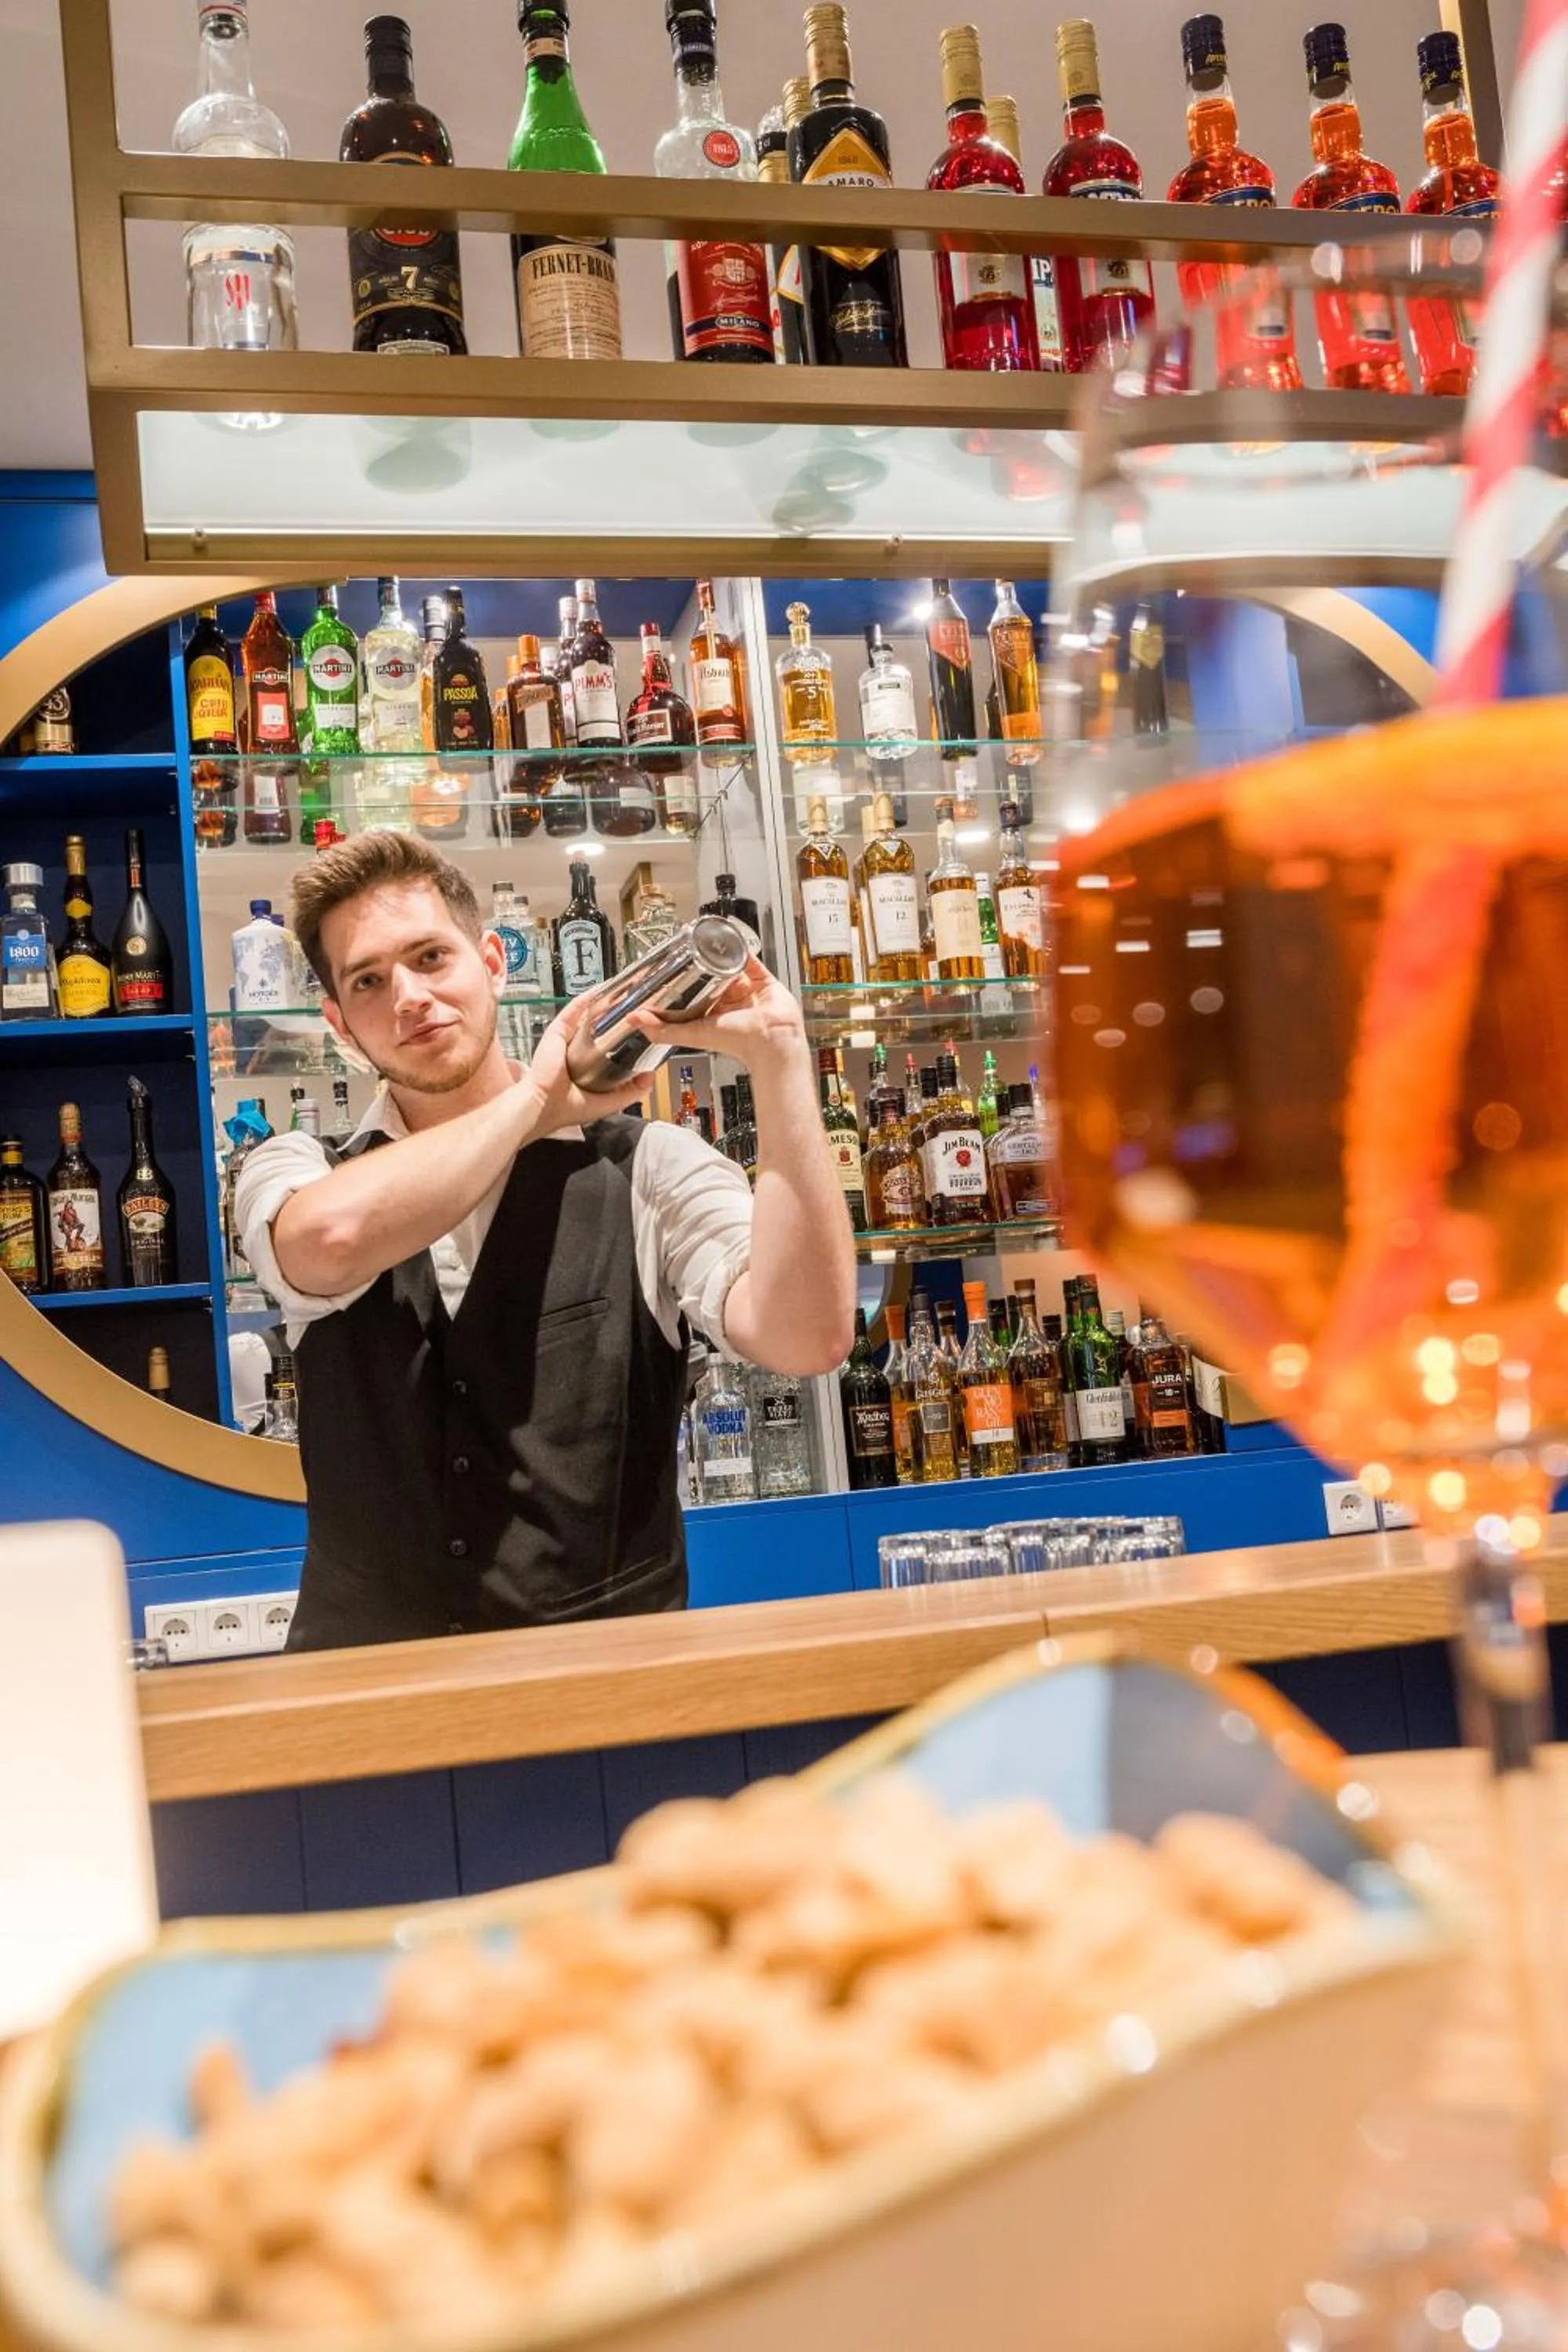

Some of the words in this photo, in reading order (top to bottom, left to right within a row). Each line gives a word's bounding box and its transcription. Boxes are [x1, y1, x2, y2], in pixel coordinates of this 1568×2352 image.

[827, 176, 875, 187] AMARO
[401, 266, 419, 289] 7
[314, 663, 352, 673] MARTINI
[376, 662, 415, 675] MARTINI
[253, 672, 289, 681] MARTINI
[575, 673, 612, 690] PIMM'S
[9, 946, 38, 958] 1800
[569, 936, 598, 977] F
[942, 1141, 957, 1156] JIM
[959, 1136, 981, 1153] BEAM
[1152, 1374, 1183, 1385] JURA
